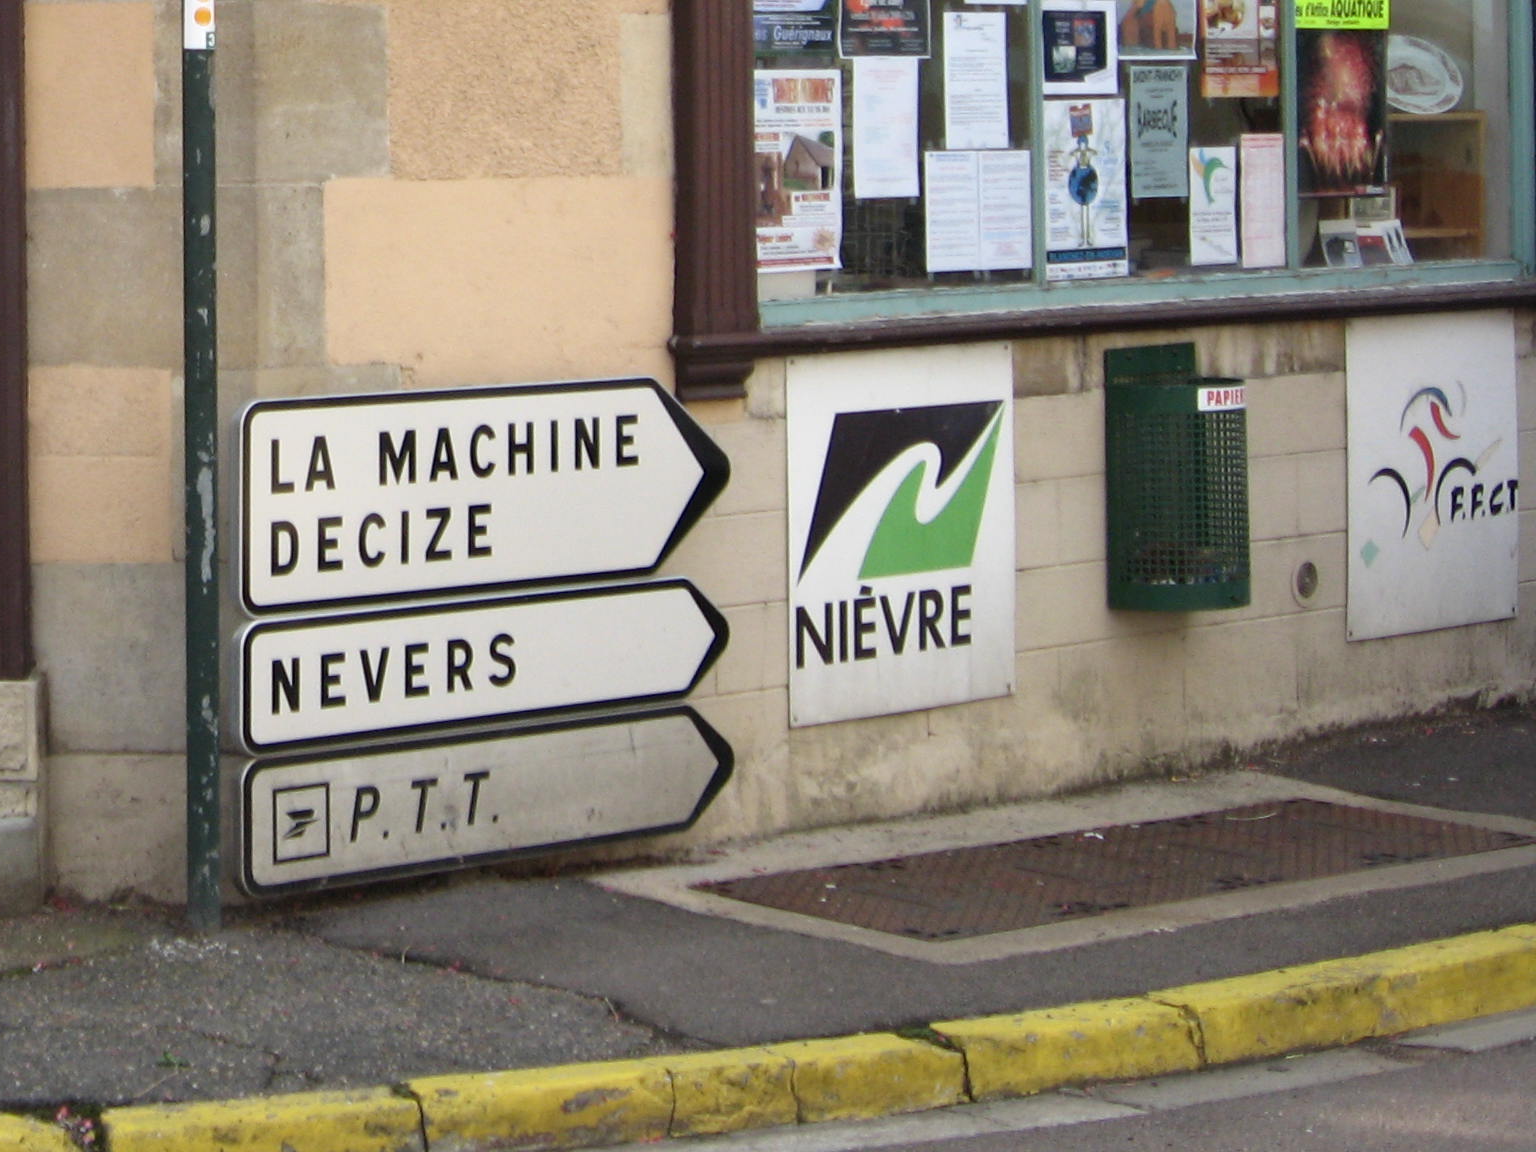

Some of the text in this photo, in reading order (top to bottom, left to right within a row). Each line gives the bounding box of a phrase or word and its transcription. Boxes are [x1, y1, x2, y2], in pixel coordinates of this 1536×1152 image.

[1330, 0, 1384, 19] AQUATIQUE
[270, 412, 640, 495] LA MACHINE
[270, 503, 494, 577] DECIZE
[795, 584, 972, 670] NIÈVRE
[271, 632, 517, 715] NEVERS
[349, 770, 500, 843] P.T.T.
